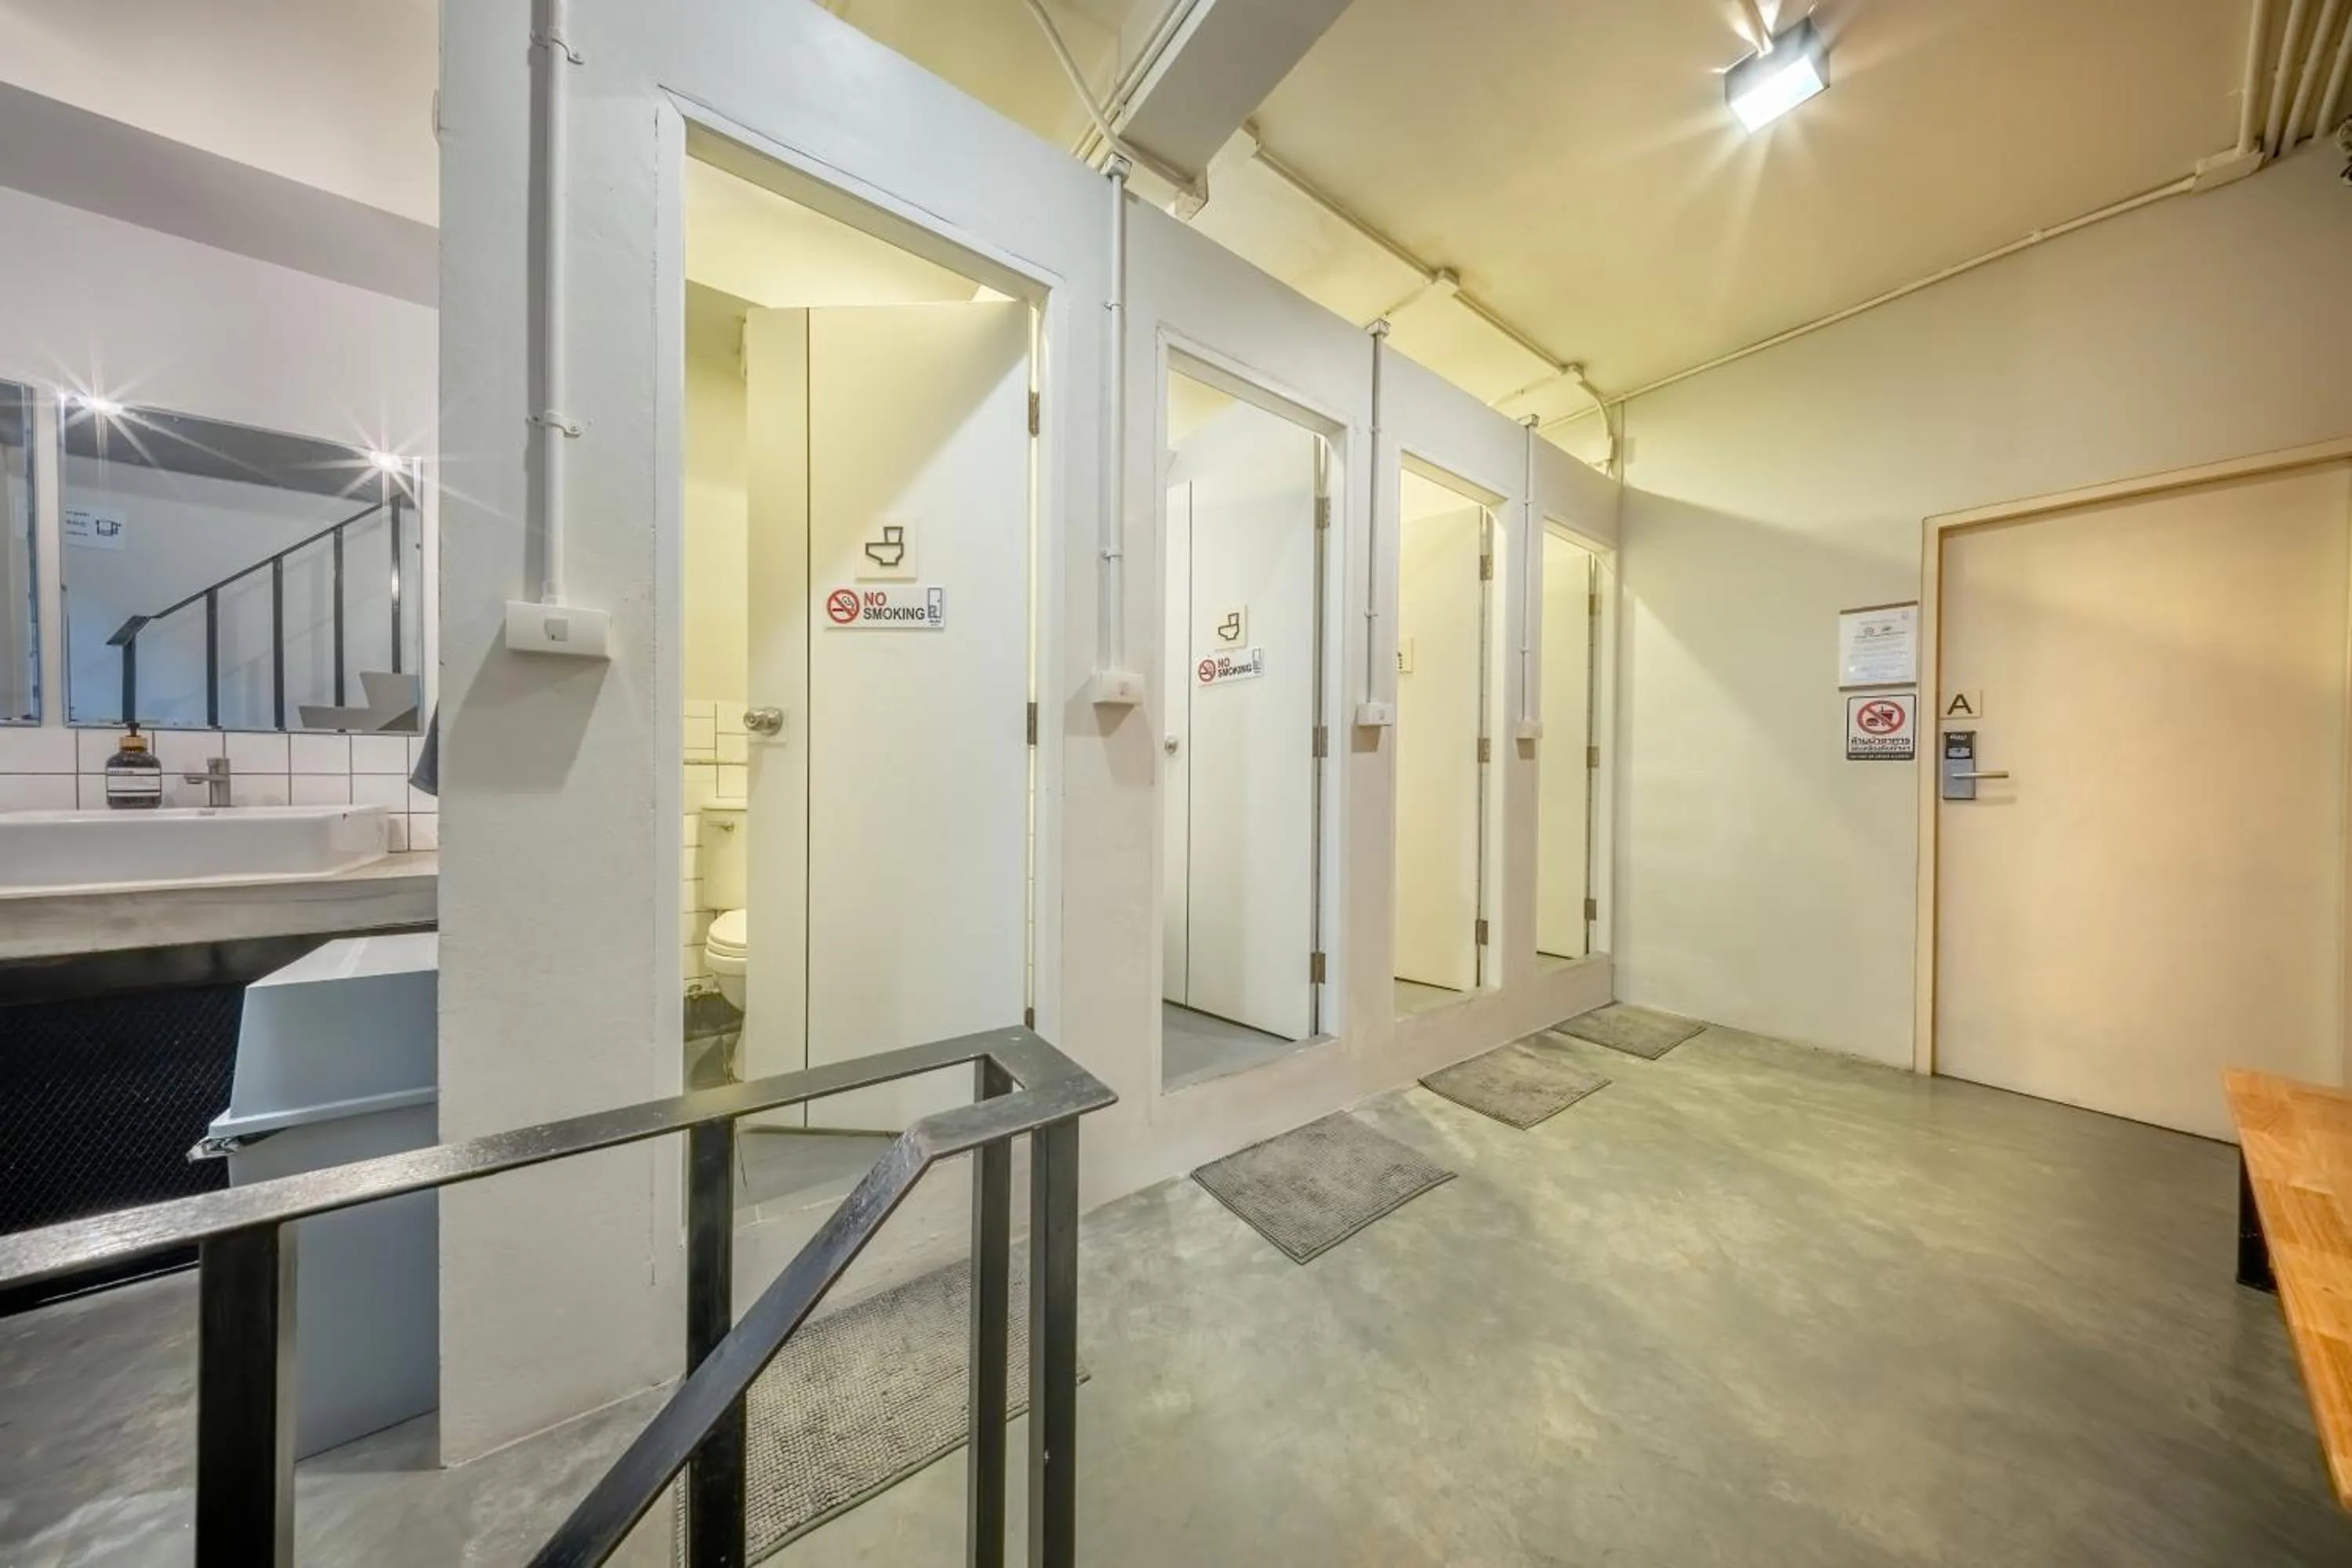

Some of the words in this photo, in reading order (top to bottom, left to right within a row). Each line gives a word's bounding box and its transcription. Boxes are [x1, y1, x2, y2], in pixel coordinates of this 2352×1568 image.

[864, 592, 887, 606] NO
[863, 608, 925, 620] SMOKING
[1218, 657, 1230, 668] NO
[1947, 693, 1973, 715] A
